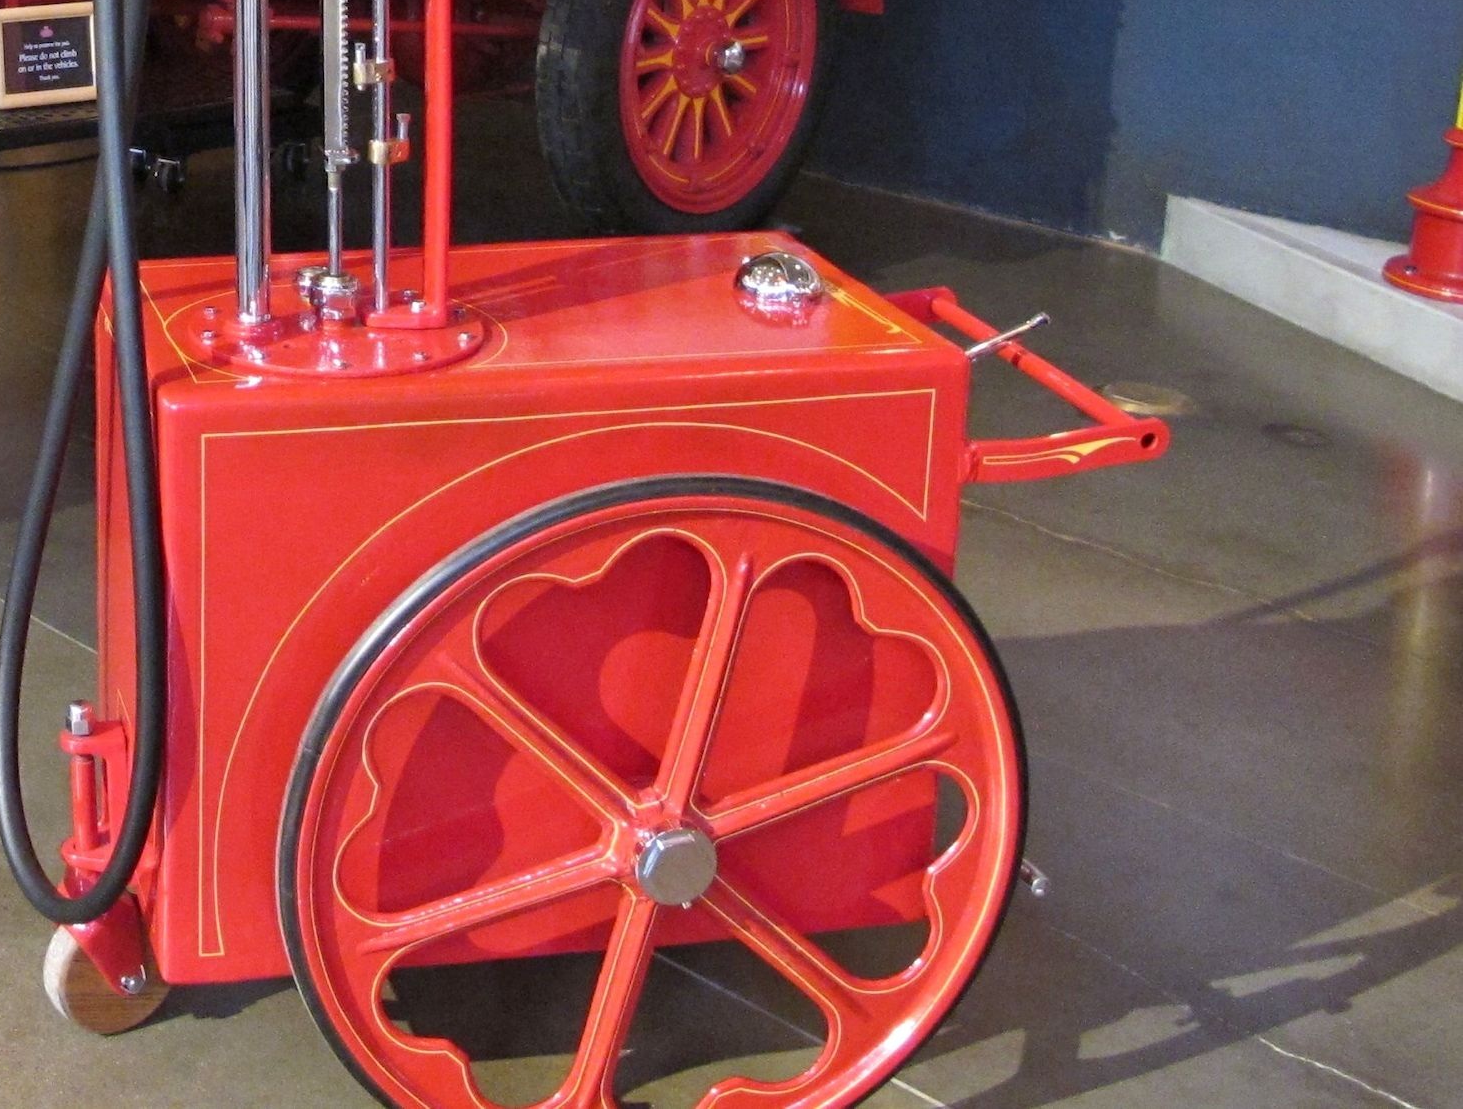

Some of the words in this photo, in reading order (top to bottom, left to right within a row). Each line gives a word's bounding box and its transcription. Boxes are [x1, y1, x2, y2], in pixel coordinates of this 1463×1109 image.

[19, 53, 38, 62] Please
[39, 52, 48, 60] do
[60, 49, 77, 58] climb
[43, 62, 53, 70] the
